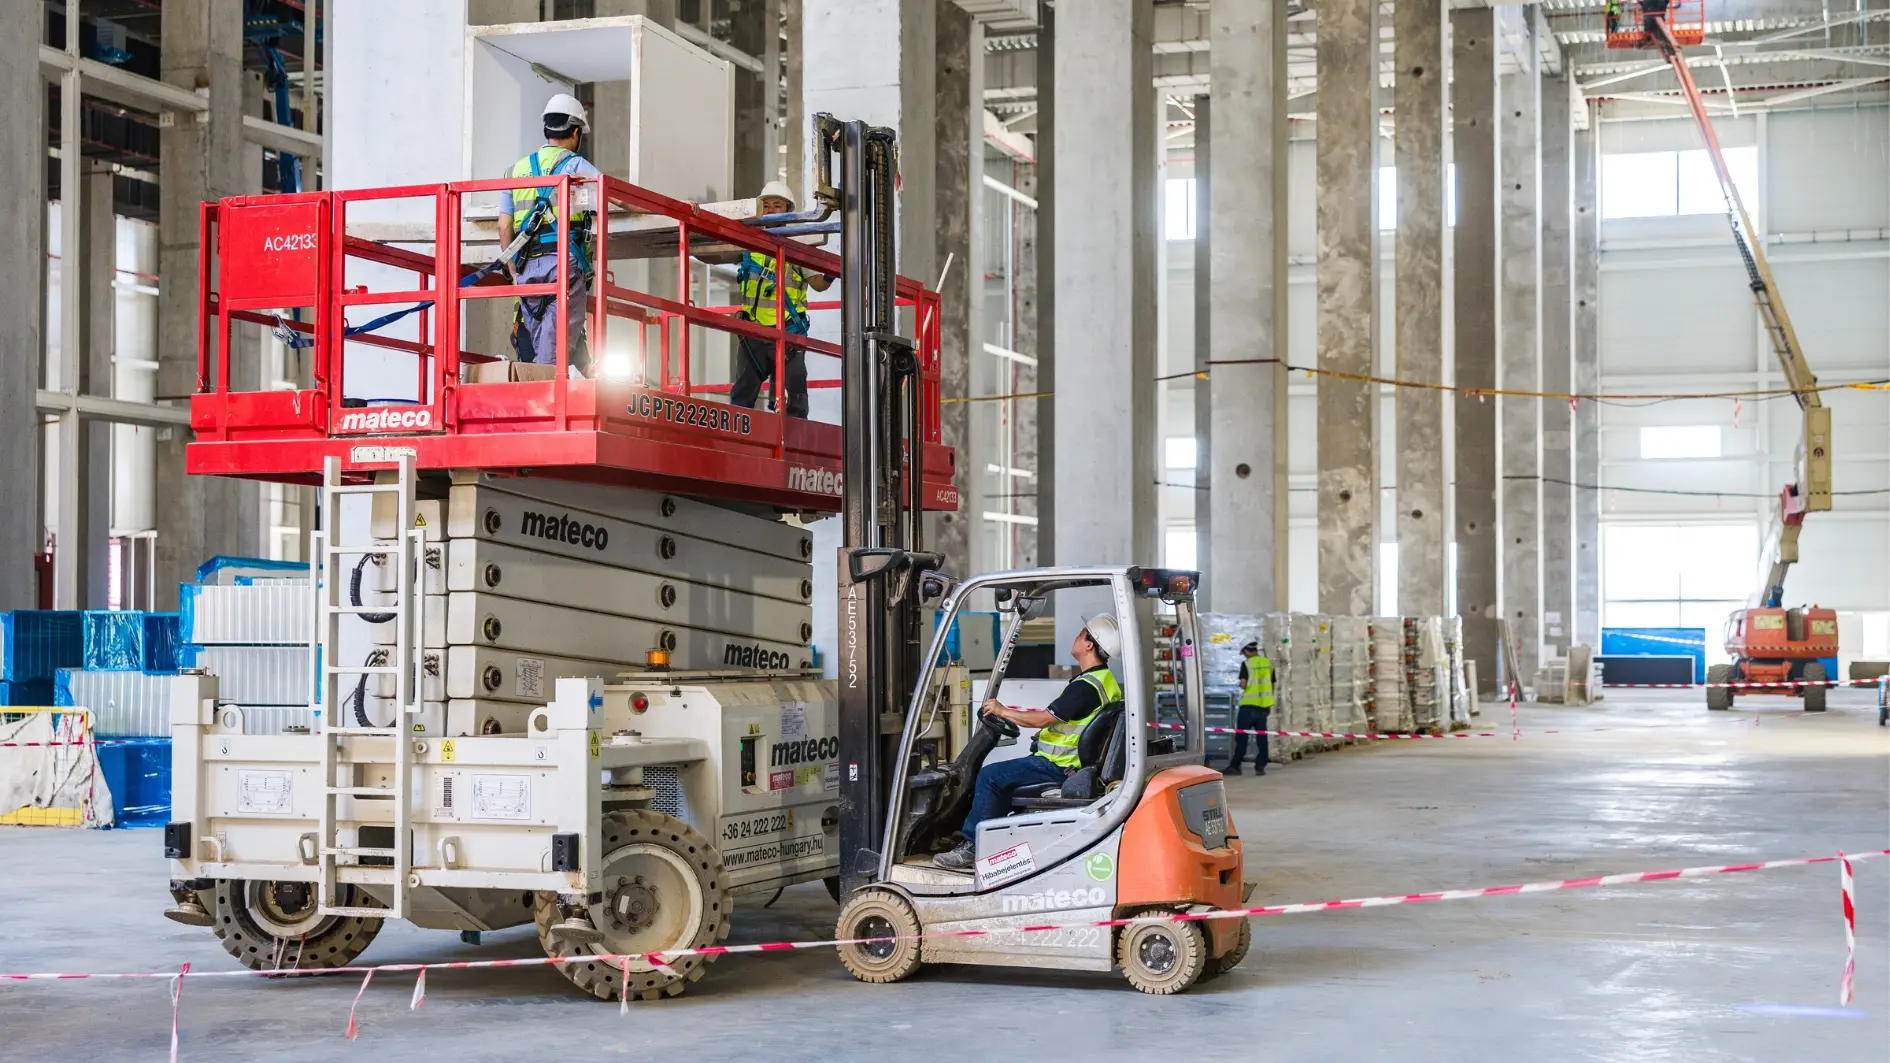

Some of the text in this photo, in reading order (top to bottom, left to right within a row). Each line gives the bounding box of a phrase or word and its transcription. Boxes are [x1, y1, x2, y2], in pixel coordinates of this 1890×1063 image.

[263, 232, 317, 252] AC42133
[342, 408, 431, 430] mateco
[787, 466, 843, 496] matec
[936, 489, 957, 504] AC42133
[520, 510, 608, 551] mateco
[847, 586, 857, 688] AE53752
[723, 642, 790, 669] mateco
[771, 734, 839, 767] mateco
[722, 814, 786, 841] +36 24 222 222
[1203, 808, 1223, 821] STILL
[723, 837, 822, 867] www.mateco-hungary.hu
[1002, 887, 1106, 912] mateco
[1030, 927, 1063, 947] 222
[1067, 927, 1099, 948] 222
